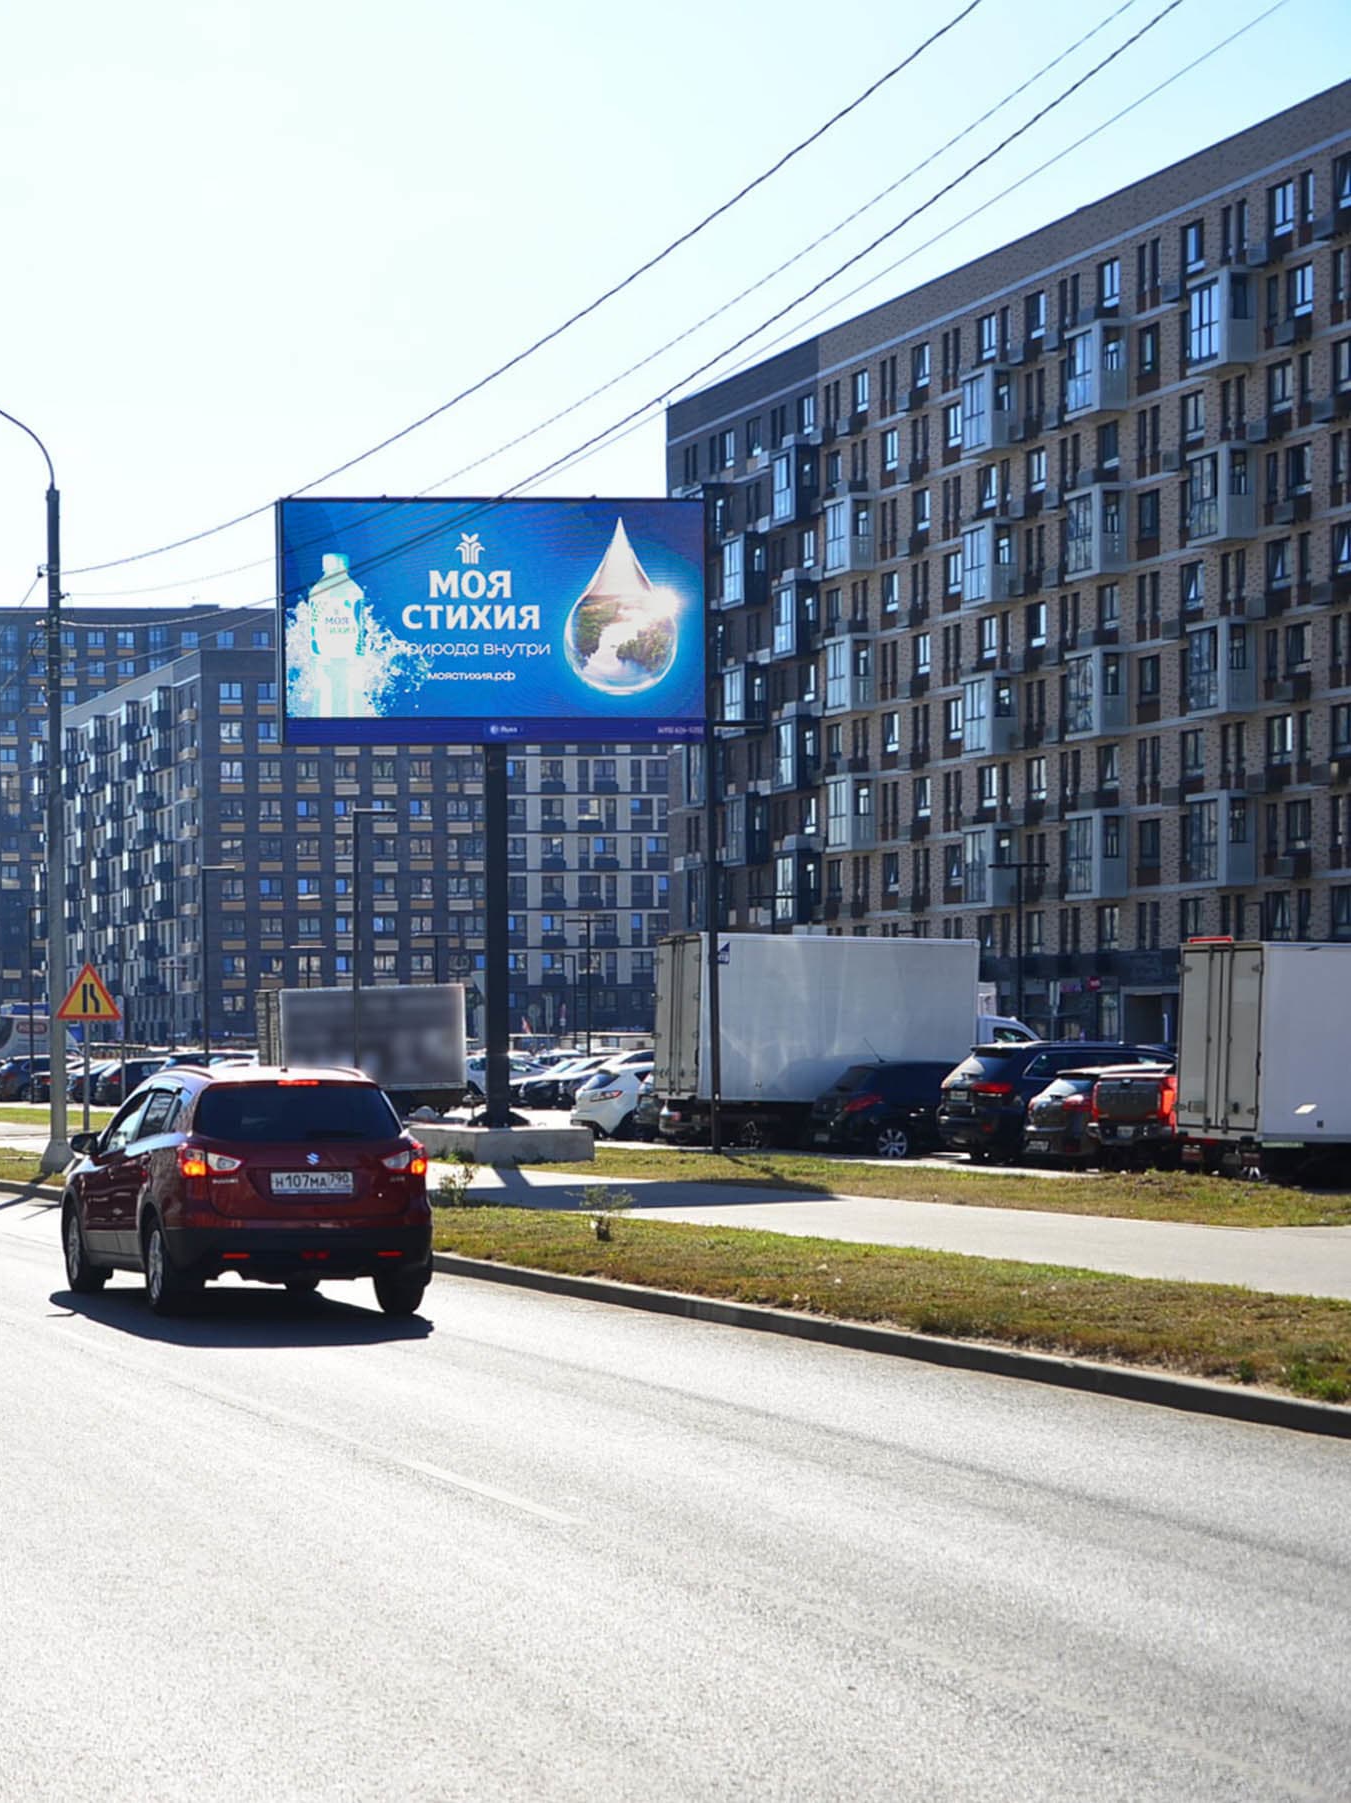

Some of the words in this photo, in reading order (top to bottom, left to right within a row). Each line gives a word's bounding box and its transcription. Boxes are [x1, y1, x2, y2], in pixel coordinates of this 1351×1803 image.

[429, 570, 512, 599] МОЯ
[401, 604, 541, 630] СТИХИЯ
[400, 643, 479, 657] рирода
[483, 643, 551, 658] внутри
[427, 672, 516, 681] моястихия.рф
